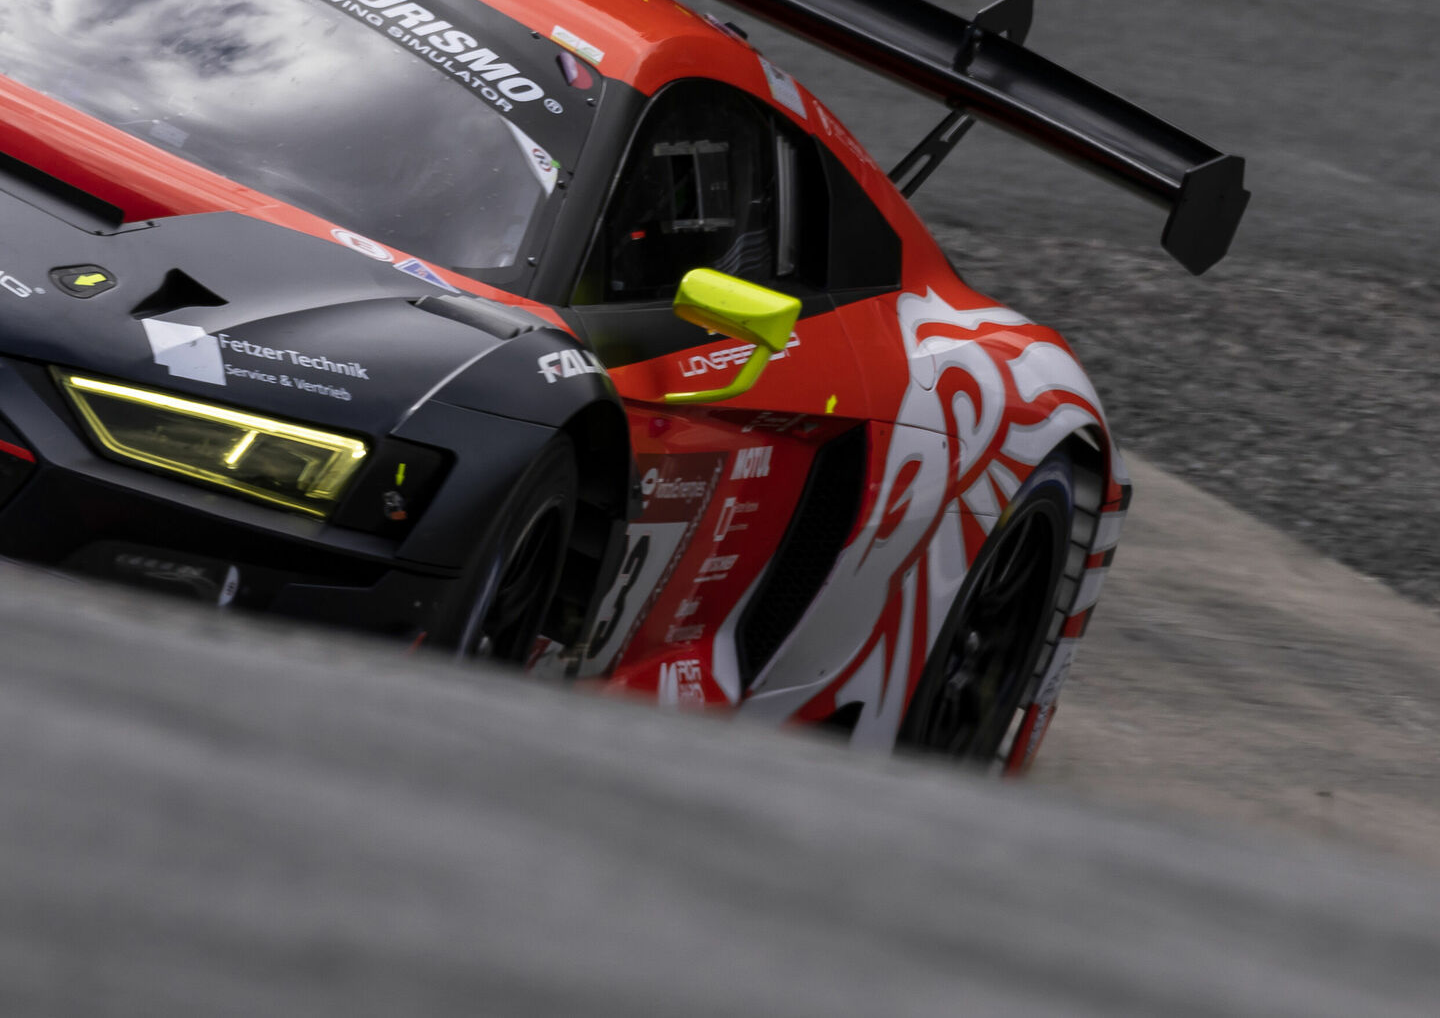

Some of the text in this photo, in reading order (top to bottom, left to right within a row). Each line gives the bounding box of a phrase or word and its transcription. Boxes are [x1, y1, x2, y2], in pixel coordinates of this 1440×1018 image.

[386, 25, 515, 113] SIMULATOR
[218, 333, 370, 381] Fetzer Technik
[224, 364, 353, 402] Service & Vertrieb
